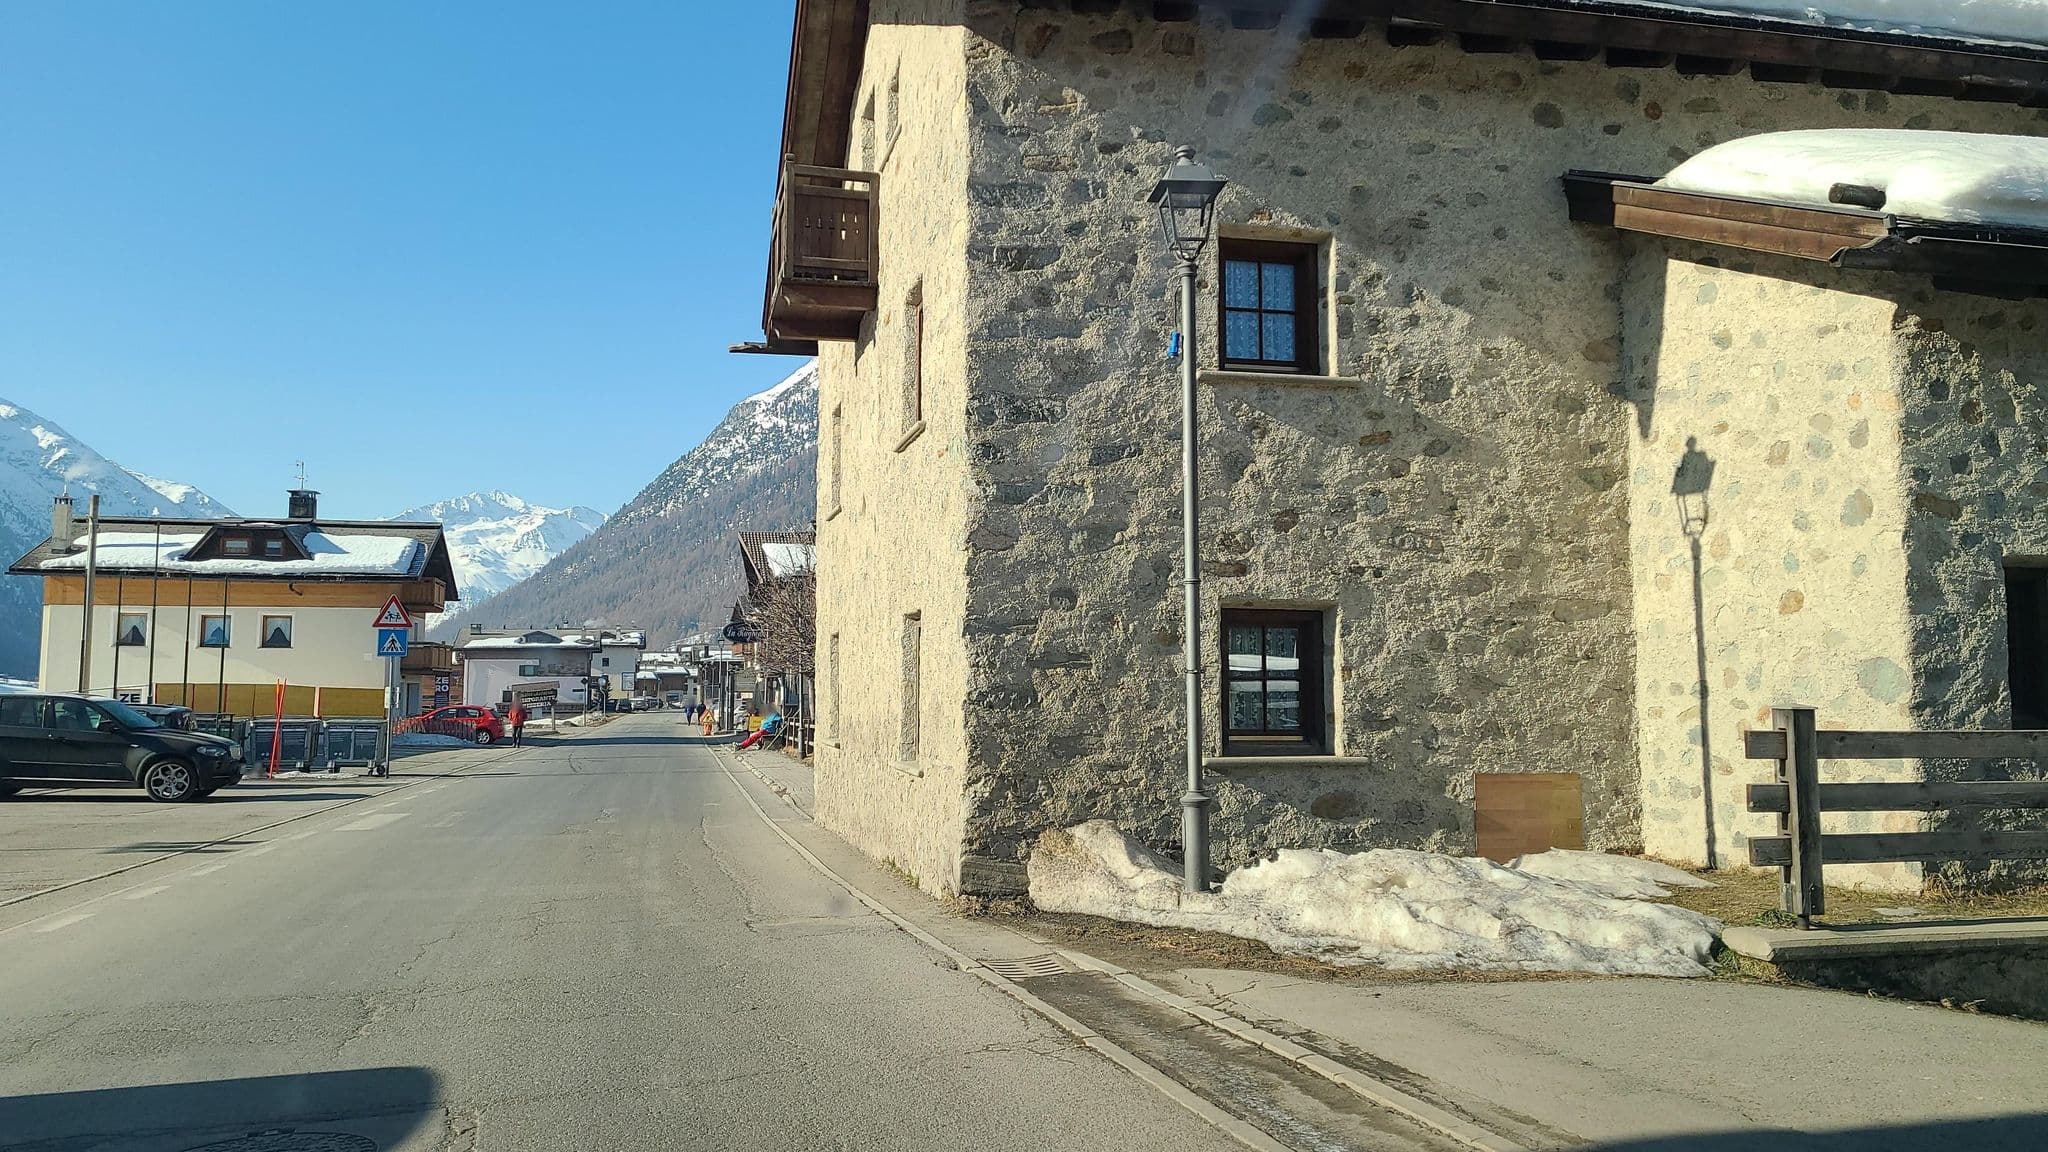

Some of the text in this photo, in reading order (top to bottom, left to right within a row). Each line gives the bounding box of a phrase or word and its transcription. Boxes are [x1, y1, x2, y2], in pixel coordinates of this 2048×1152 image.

[435, 676, 449, 685] ZE
[435, 684, 449, 693] RO
[119, 693, 141, 703] ZE
